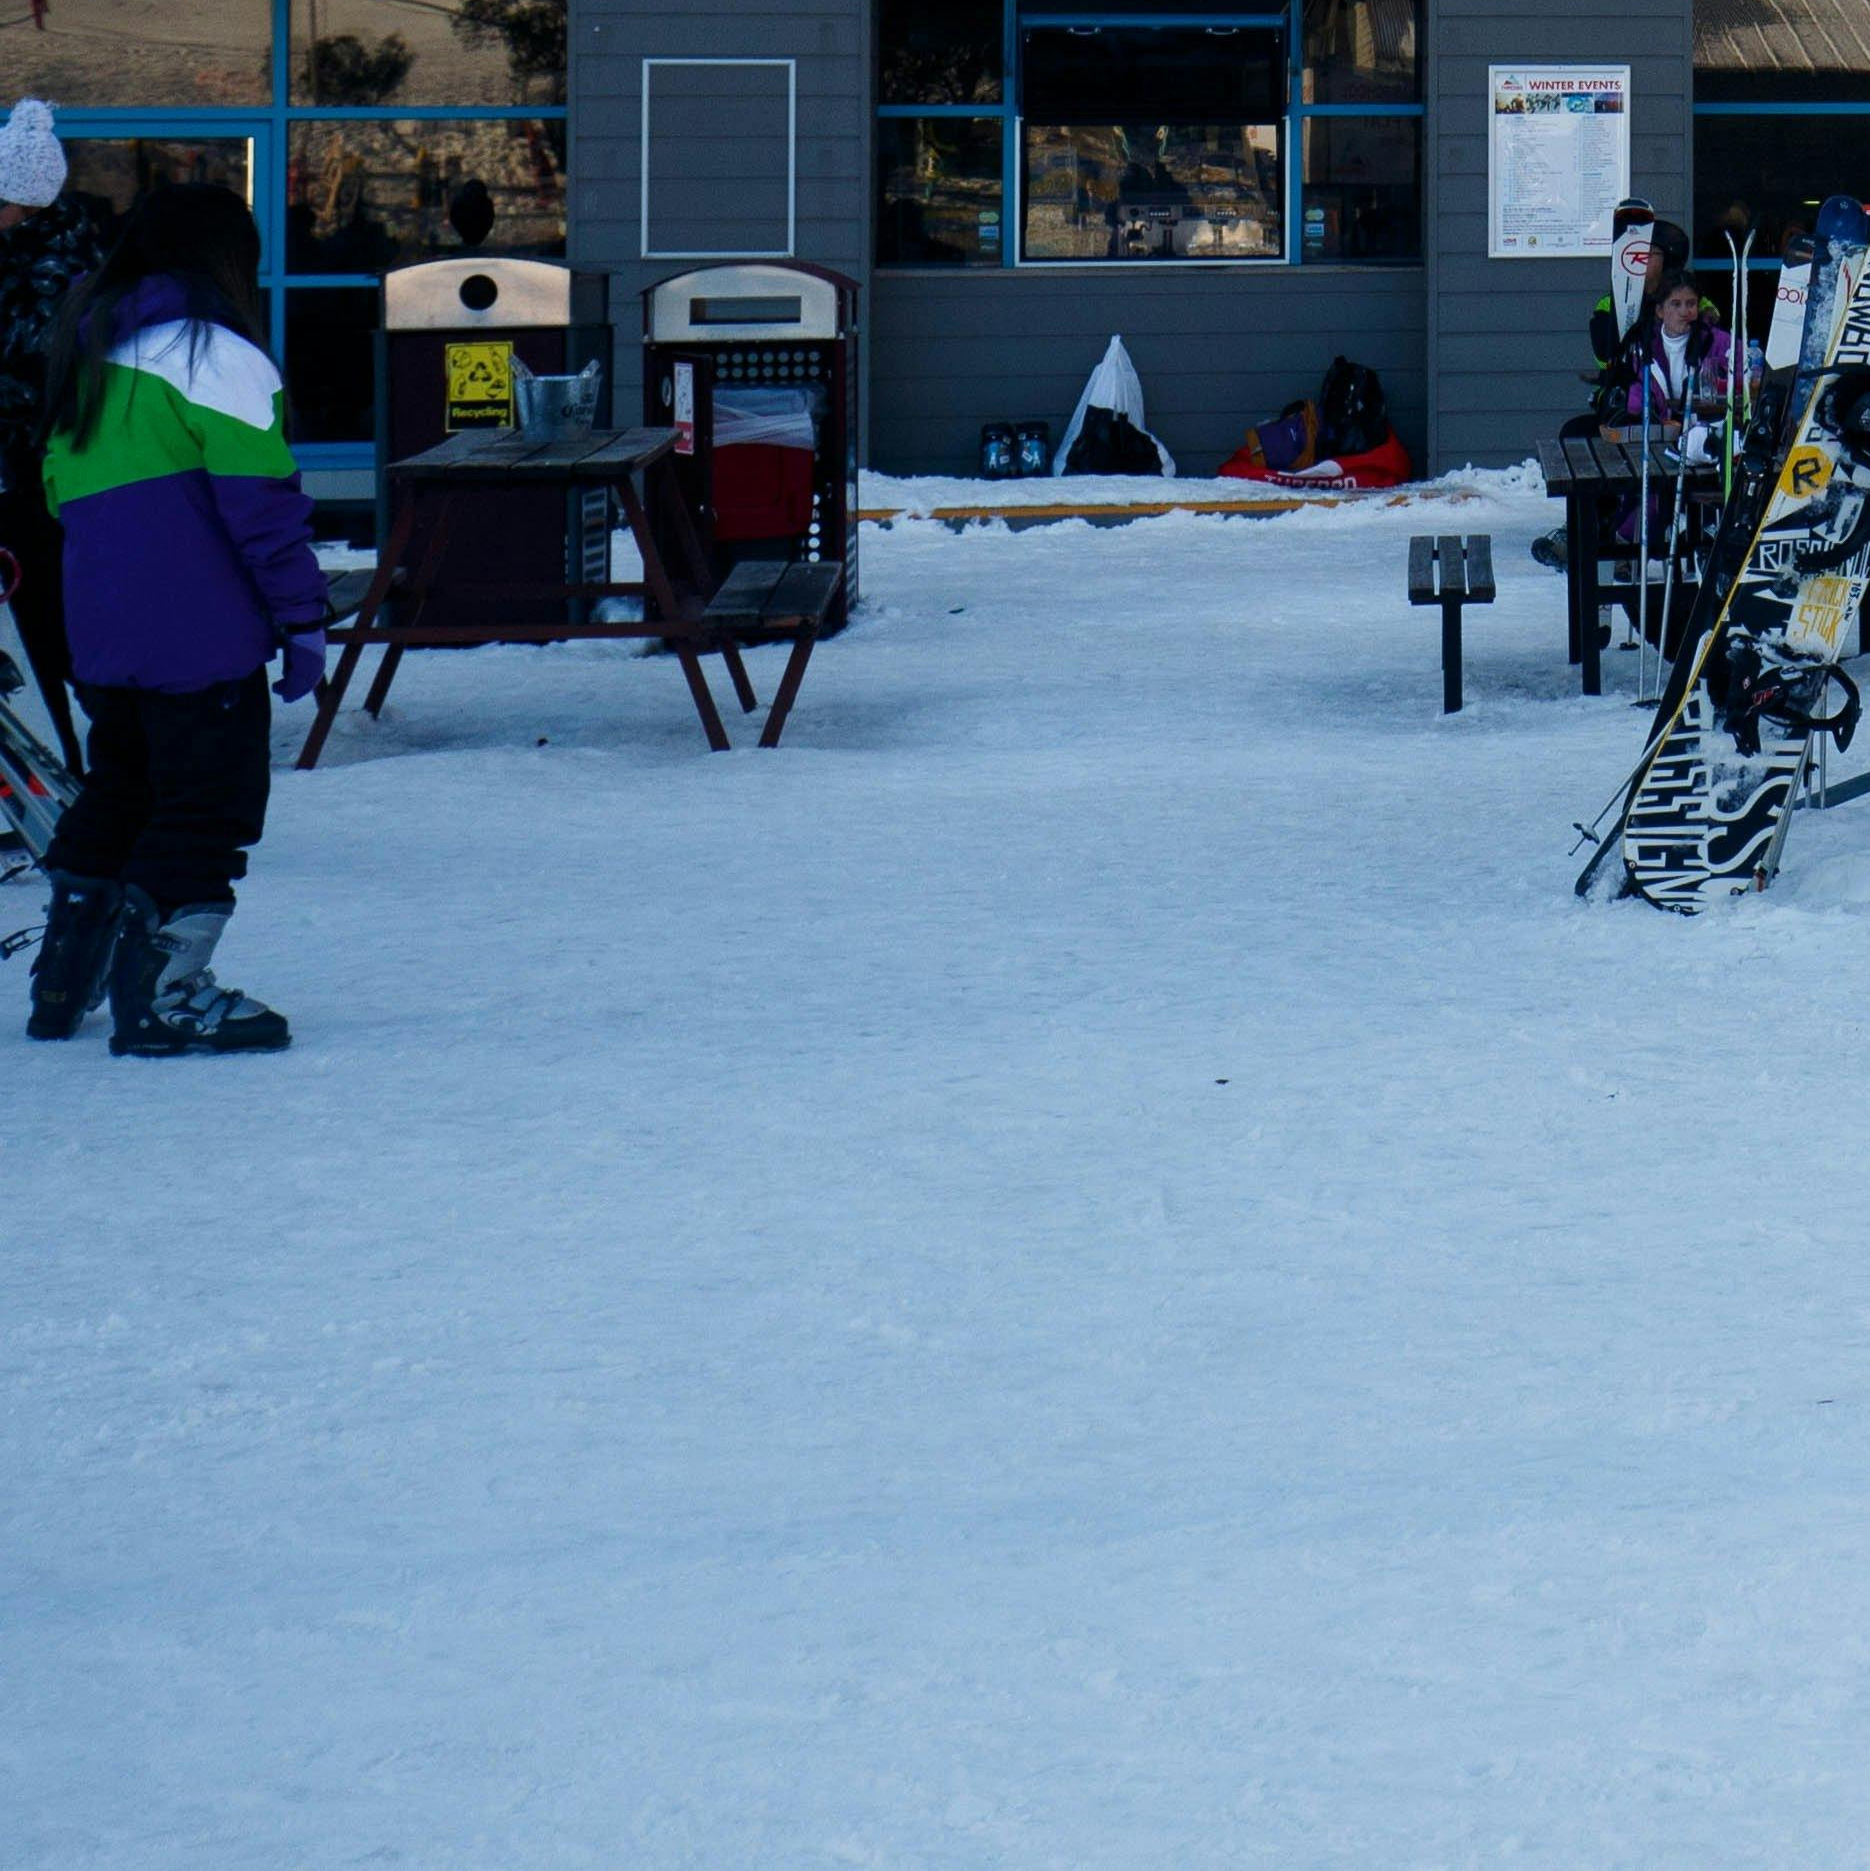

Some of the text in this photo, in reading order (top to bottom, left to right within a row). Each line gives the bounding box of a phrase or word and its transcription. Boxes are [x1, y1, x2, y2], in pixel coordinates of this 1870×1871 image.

[1529, 80, 1574, 90] WINTER
[1578, 80, 1621, 90] EVENTS
[451, 406, 508, 421] Recycling
